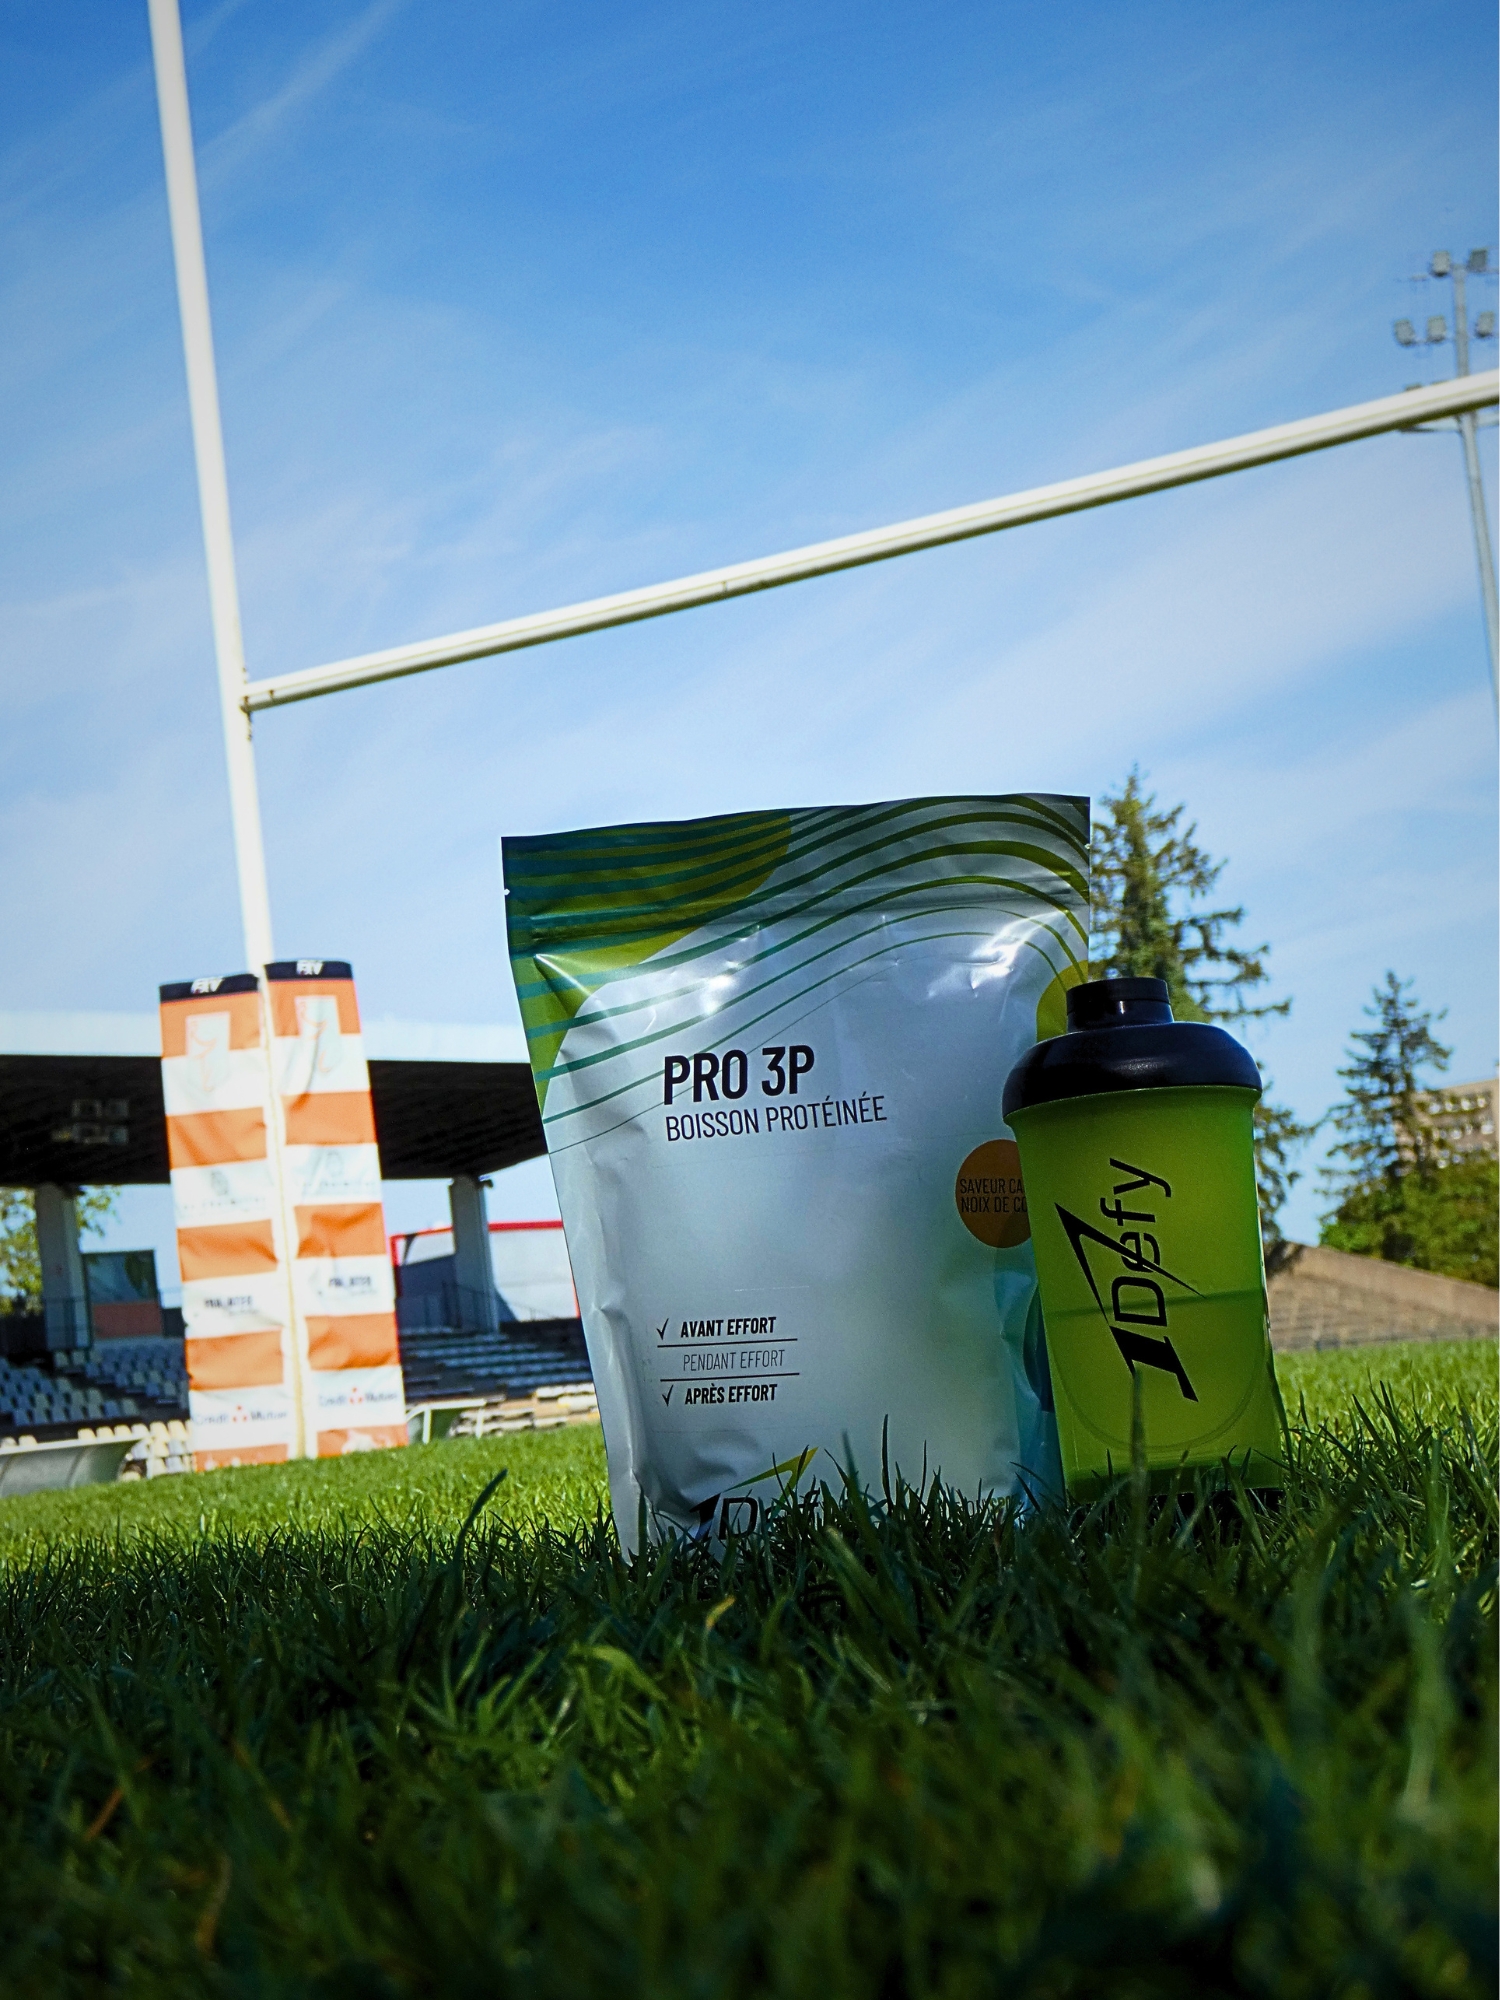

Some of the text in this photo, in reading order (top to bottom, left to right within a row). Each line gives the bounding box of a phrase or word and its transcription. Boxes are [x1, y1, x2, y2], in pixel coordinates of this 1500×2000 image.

[664, 1044, 815, 1105] PRO 3P
[665, 1091, 888, 1141] BOISSON PROTÉINÉE
[960, 1178, 1006, 1194] SAVEUR
[961, 1197, 990, 1213] NOIX
[994, 1197, 1010, 1213] DE
[680, 1316, 777, 1338] AVANT EFFORT
[683, 1349, 786, 1372] PENDANT EFFORT
[684, 1382, 778, 1405] APRÈS EFFORT
